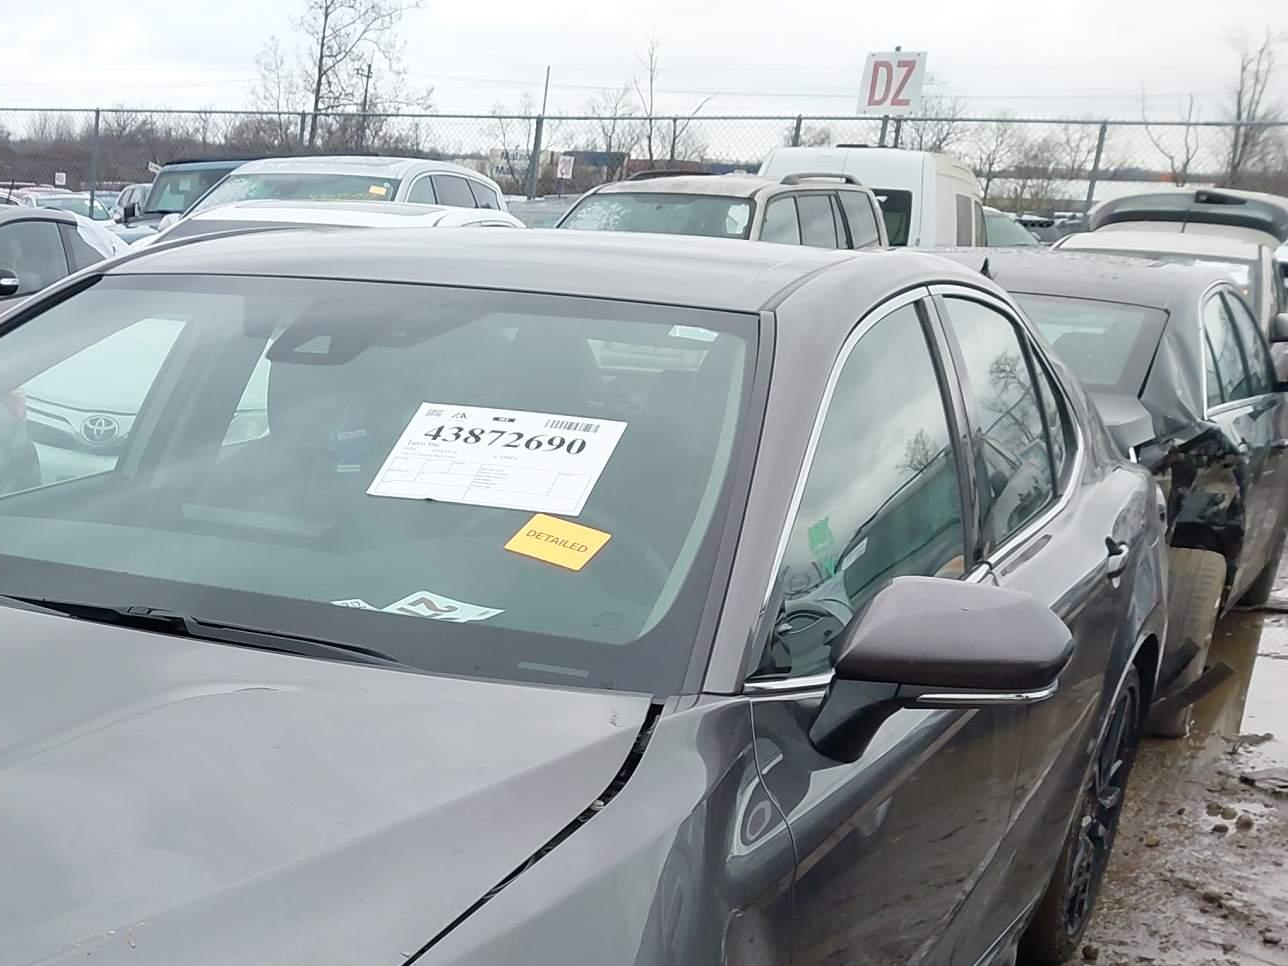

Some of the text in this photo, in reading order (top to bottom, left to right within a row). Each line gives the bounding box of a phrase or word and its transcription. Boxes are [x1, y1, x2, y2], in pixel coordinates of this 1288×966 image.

[867, 60, 916, 106] DZ
[424, 425, 587, 455] 43872690
[526, 529, 589, 554] DETAILED
